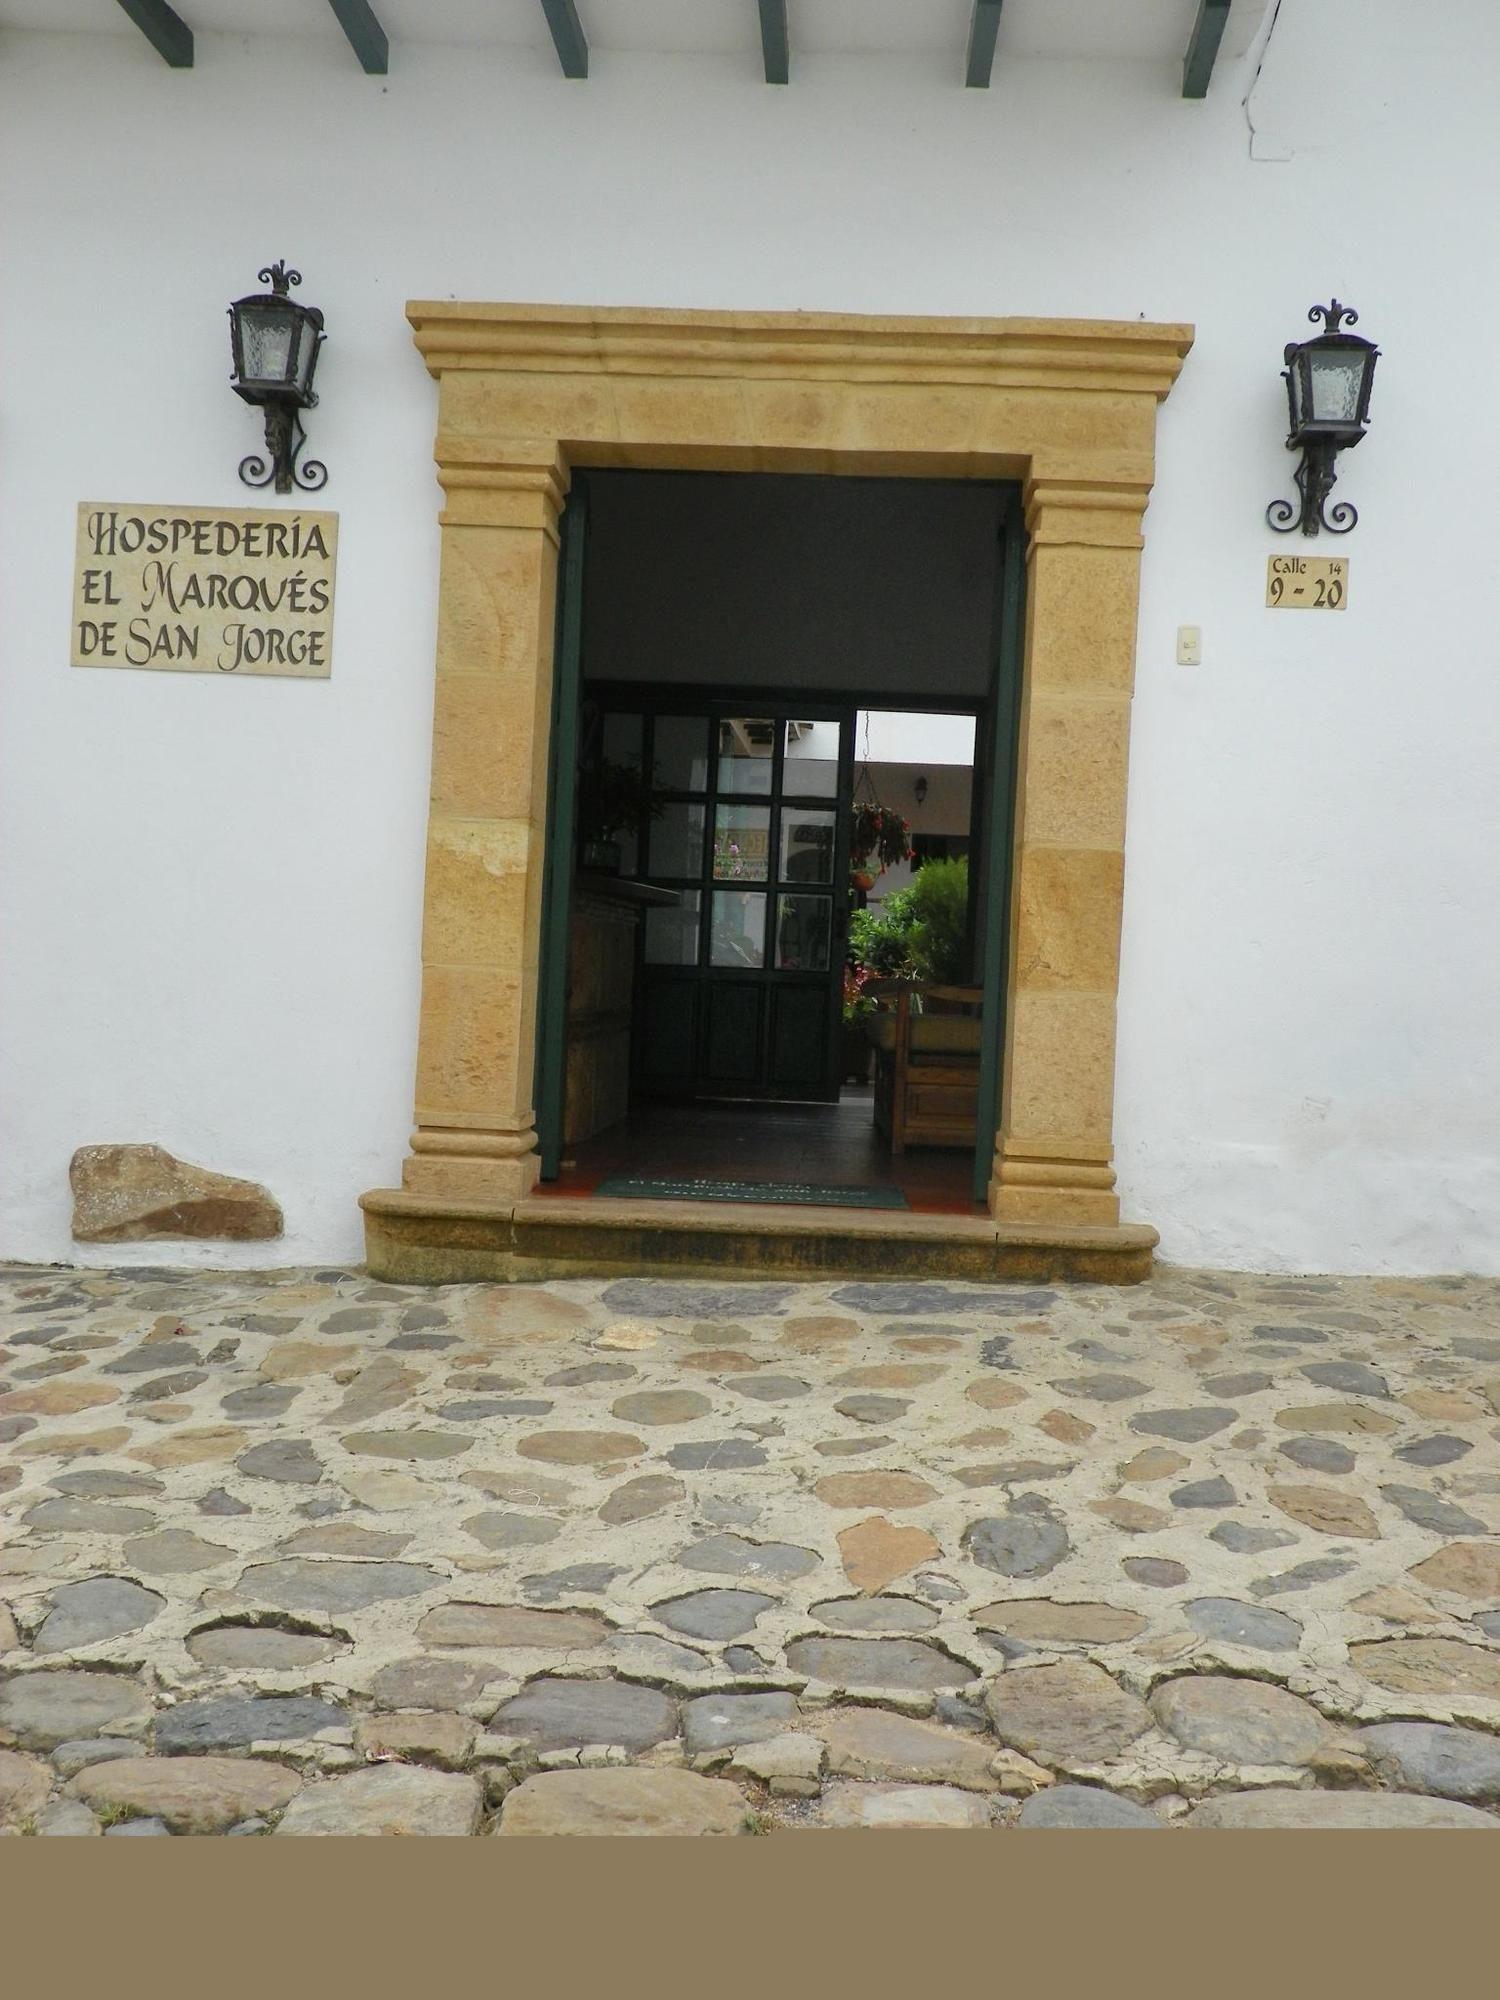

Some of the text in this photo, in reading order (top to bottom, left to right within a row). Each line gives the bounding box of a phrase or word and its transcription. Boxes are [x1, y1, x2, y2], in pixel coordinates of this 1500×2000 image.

[88, 512, 330, 560] HOSPEDERÍA
[1272, 558, 1342, 575] Calle 14
[82, 570, 122, 605] EL
[1313, 579, 1343, 608] 20
[78, 618, 325, 672] DE SAN JORGE
